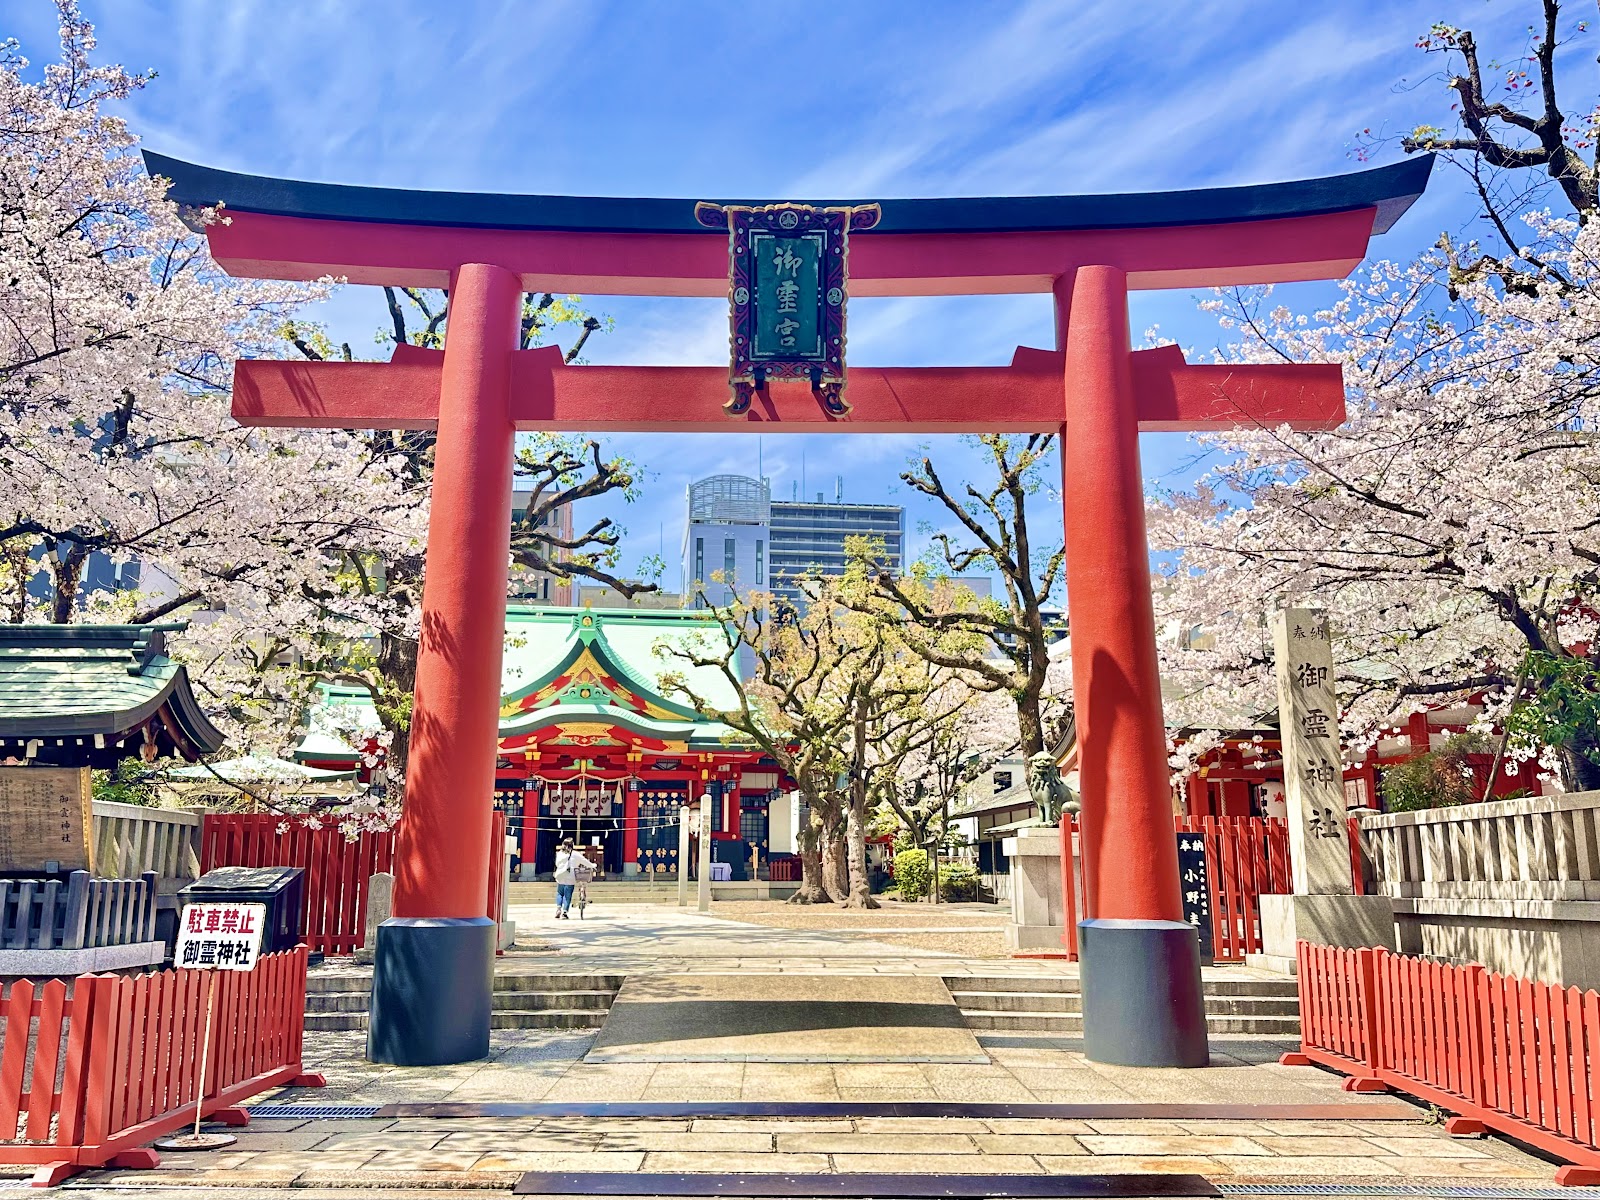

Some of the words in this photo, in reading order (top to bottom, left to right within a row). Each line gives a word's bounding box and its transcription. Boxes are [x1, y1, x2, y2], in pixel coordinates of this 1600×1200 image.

[1293, 624, 1325, 641] 奉納
[1297, 662, 1341, 840] 御霊神社
[1179, 839, 1205, 852] 奉納
[1184, 868, 1203, 942] 小野圭
[187, 907, 255, 934] 駐車禁止
[182, 940, 251, 965] 御霊神社
